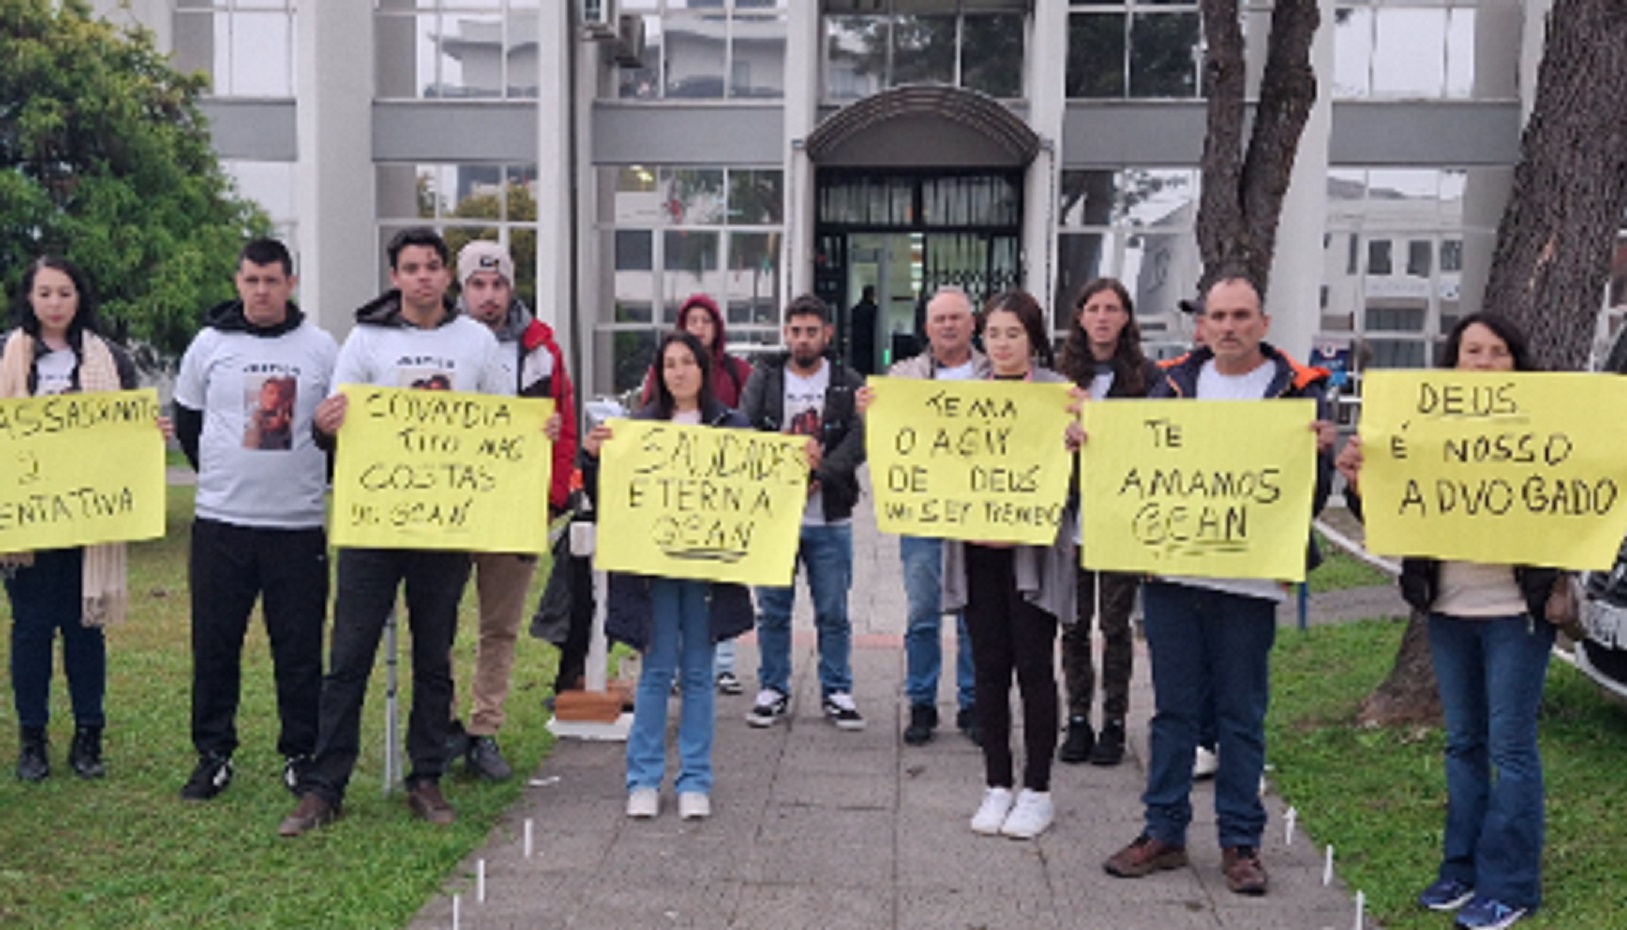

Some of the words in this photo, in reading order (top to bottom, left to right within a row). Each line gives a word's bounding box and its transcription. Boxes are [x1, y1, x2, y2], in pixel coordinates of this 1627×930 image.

[1417, 381, 1519, 417] DEUS
[1144, 418, 1183, 448] TE
[1443, 433, 1574, 467] NOSSO
[887, 464, 928, 494] DE
[970, 464, 1042, 493] DEUS
[1117, 466, 1281, 504] AMAMOS
[1398, 473, 1619, 517] ADVOGADO
[629, 478, 773, 518] ETERNA
